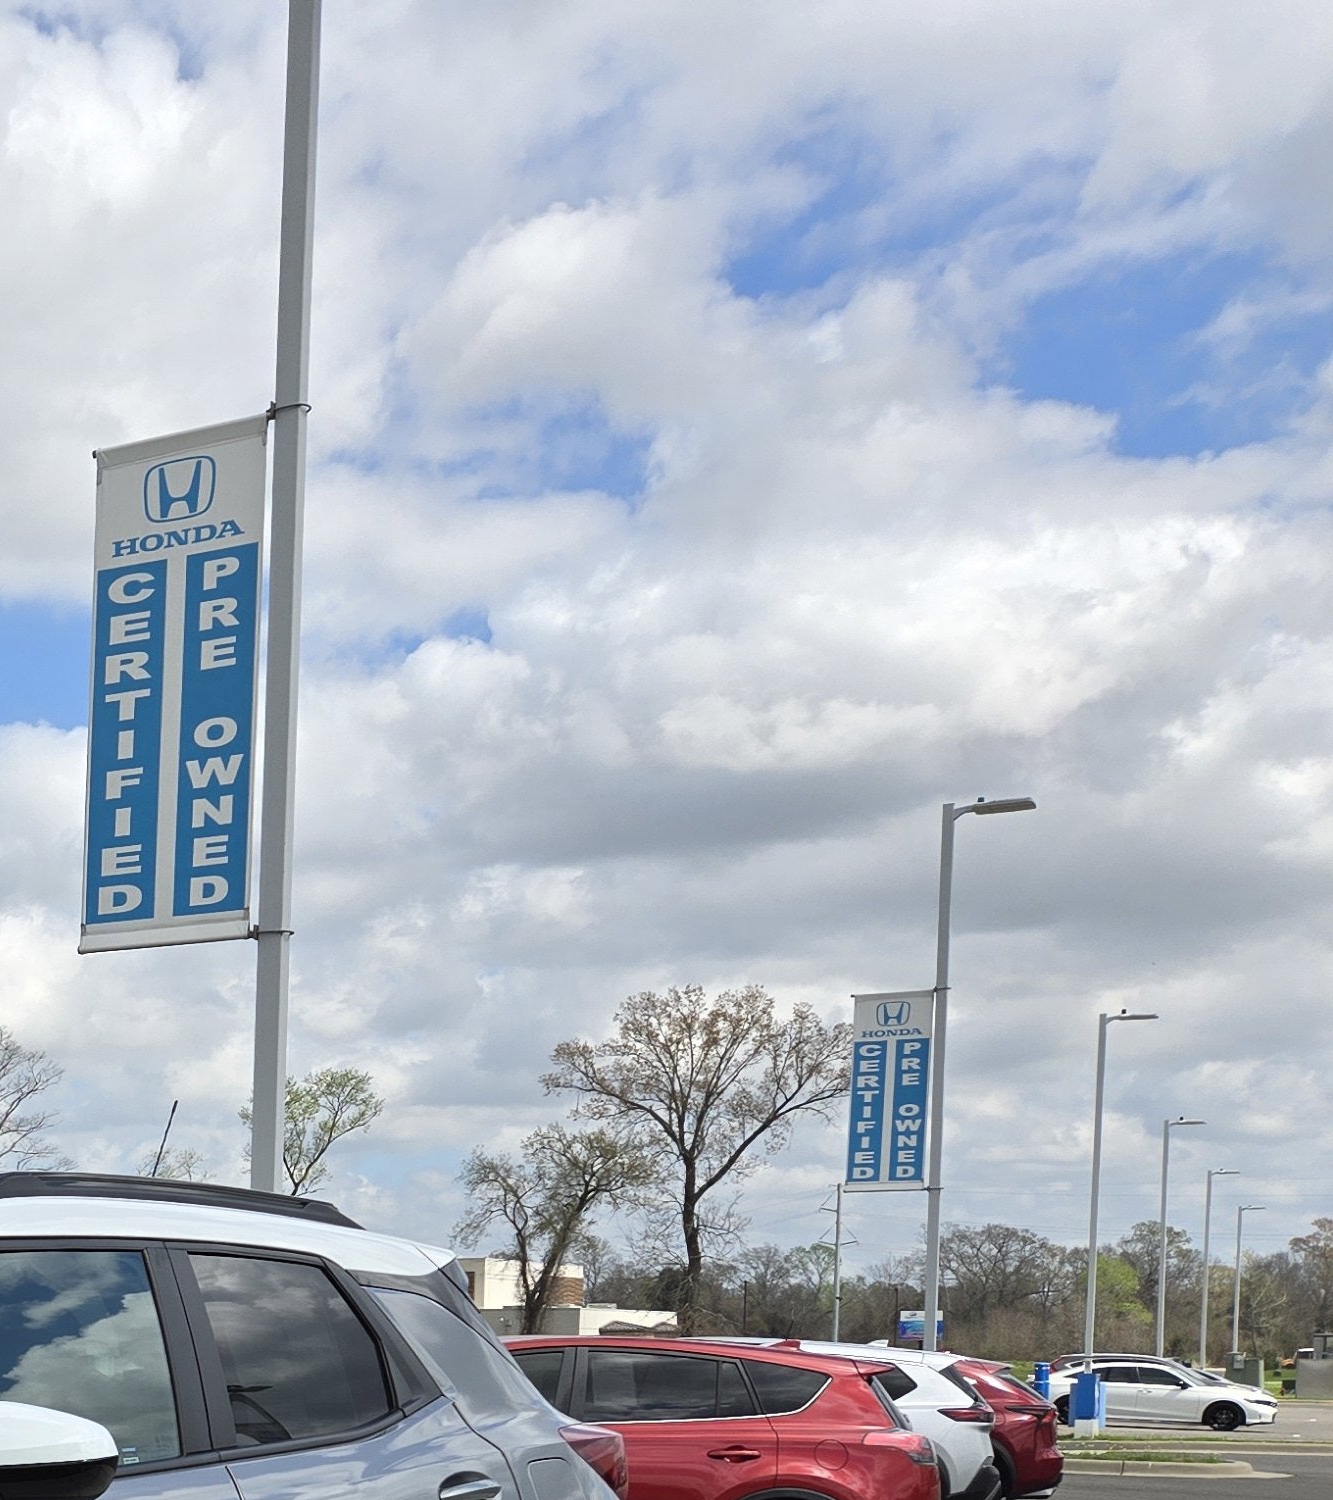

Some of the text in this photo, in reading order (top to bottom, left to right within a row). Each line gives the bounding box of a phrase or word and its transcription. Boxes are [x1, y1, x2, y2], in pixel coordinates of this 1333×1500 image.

[112, 519, 245, 558] HONDA
[97, 572, 156, 916] CERTIFIED
[186, 556, 244, 907] PRE OWNED
[861, 1027, 922, 1038] HONDA
[852, 1044, 882, 1180] CERTIFIED
[895, 1041, 922, 1178] PRE OWNED
